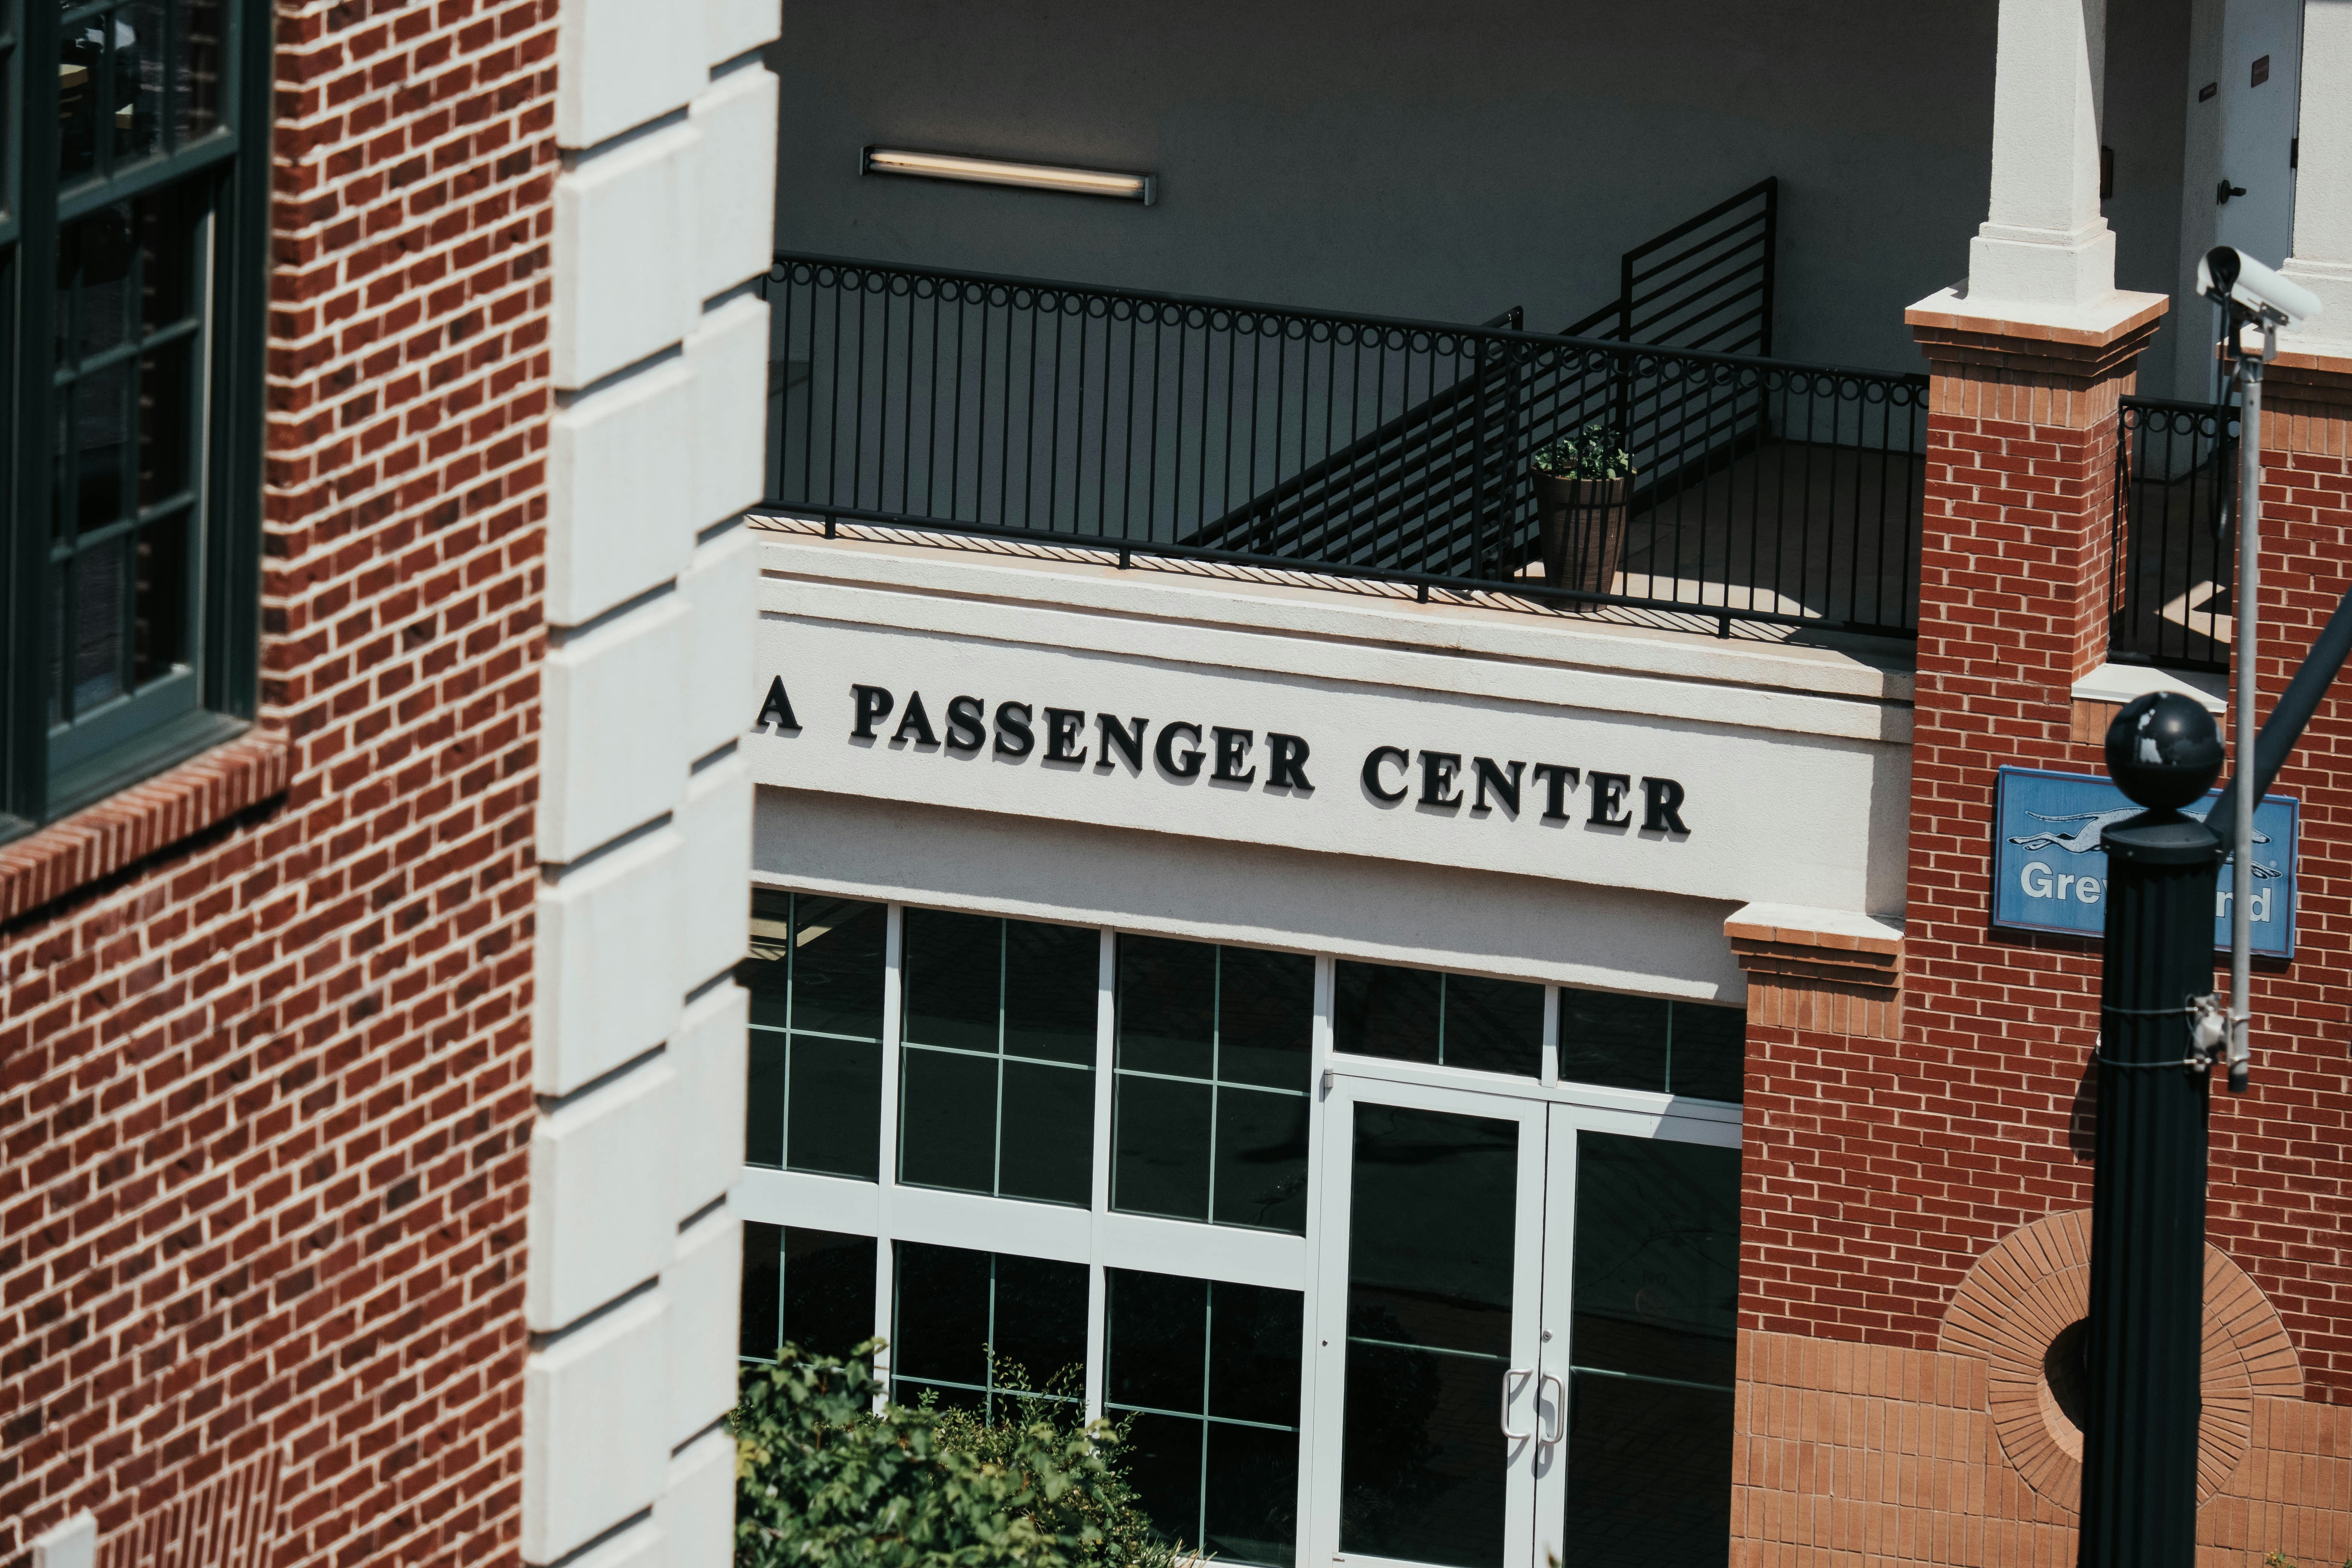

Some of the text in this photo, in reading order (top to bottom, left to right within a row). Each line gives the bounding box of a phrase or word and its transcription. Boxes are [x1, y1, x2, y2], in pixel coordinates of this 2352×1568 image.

[755, 675, 1692, 835] A PASSENGER CENTER
[2021, 861, 2272, 923] Grend
